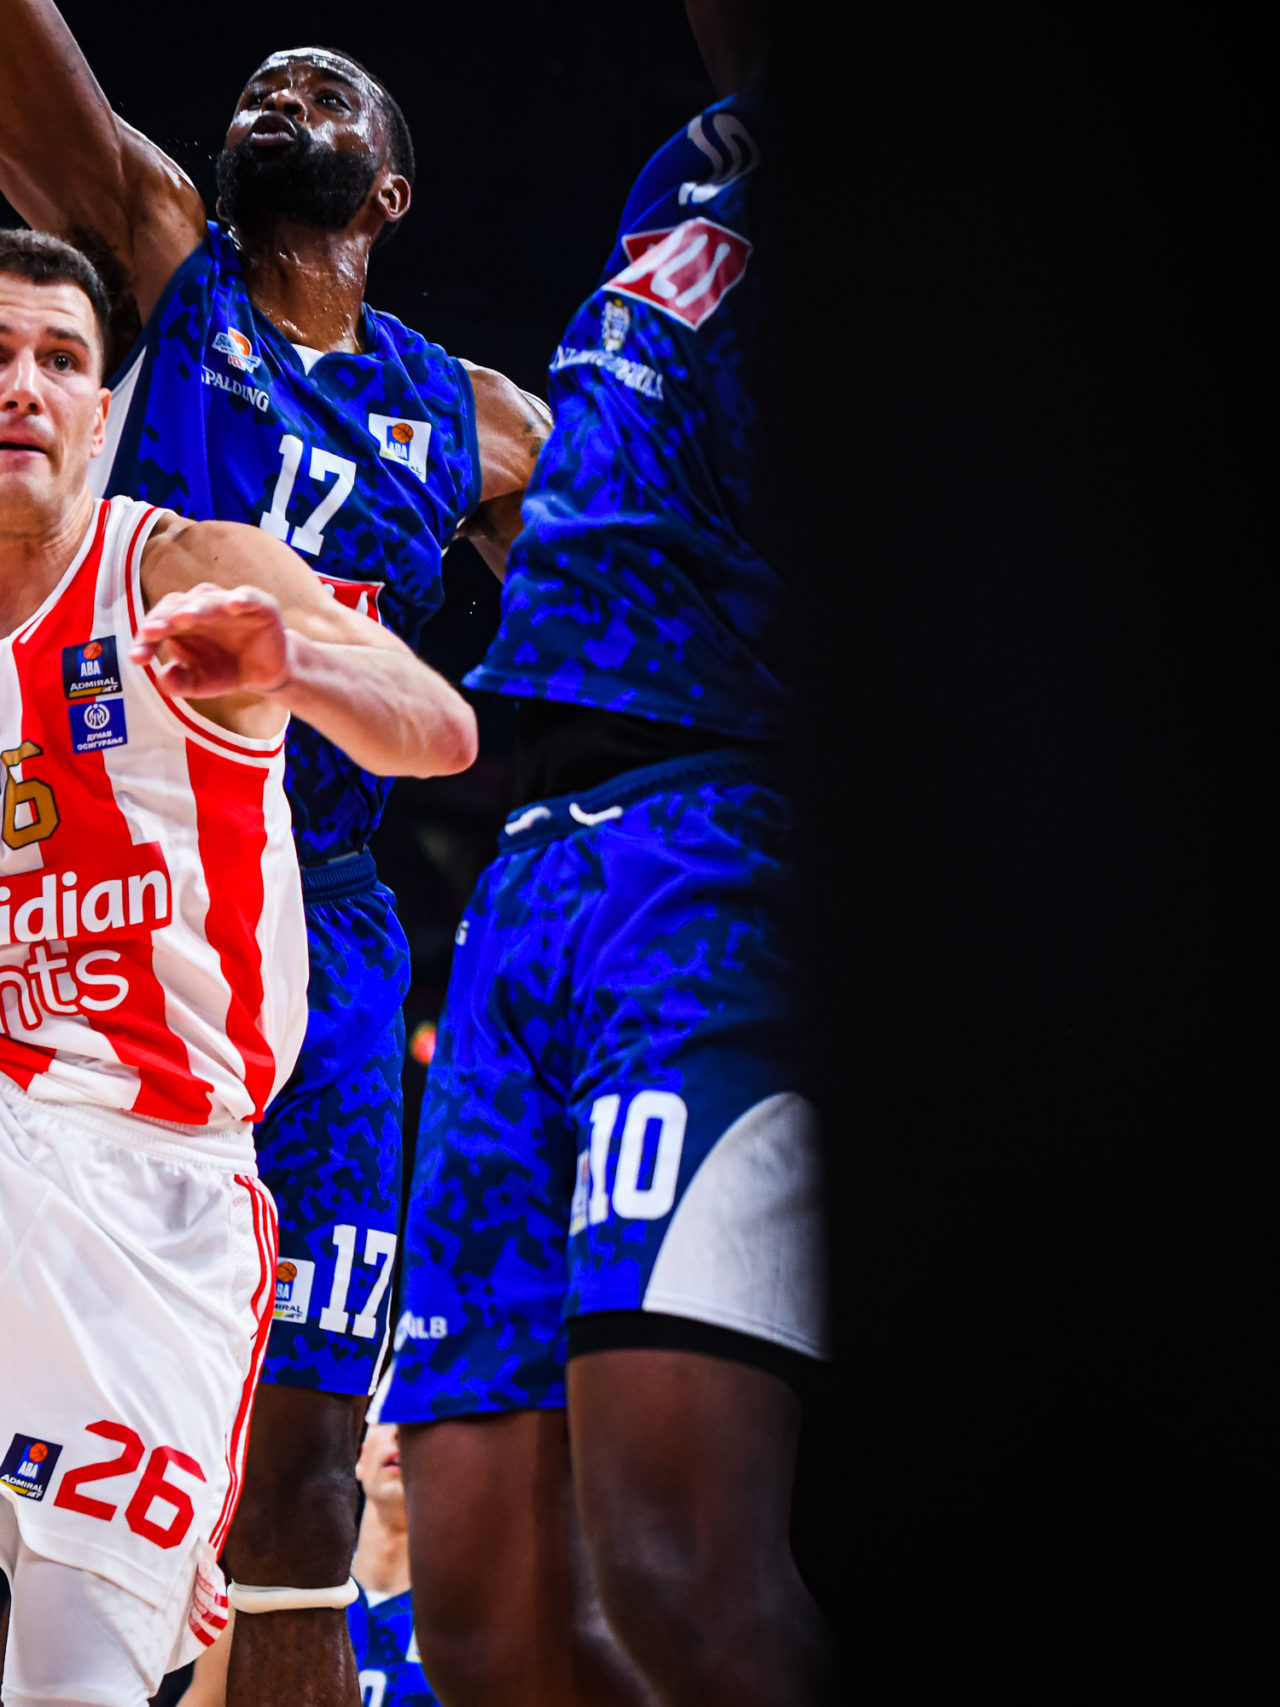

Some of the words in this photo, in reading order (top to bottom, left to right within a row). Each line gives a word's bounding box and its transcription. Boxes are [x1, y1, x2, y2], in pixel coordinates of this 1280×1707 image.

[259, 434, 357, 556] 17
[70, 677, 118, 691] ADMIRAL
[80, 660, 101, 677] ABA
[589, 1089, 688, 1226] 10
[319, 1224, 398, 1339] 17
[0, 1473, 43, 1492] ADMIRAL
[17, 1460, 39, 1479] ABA
[53, 1419, 207, 1550] 26
